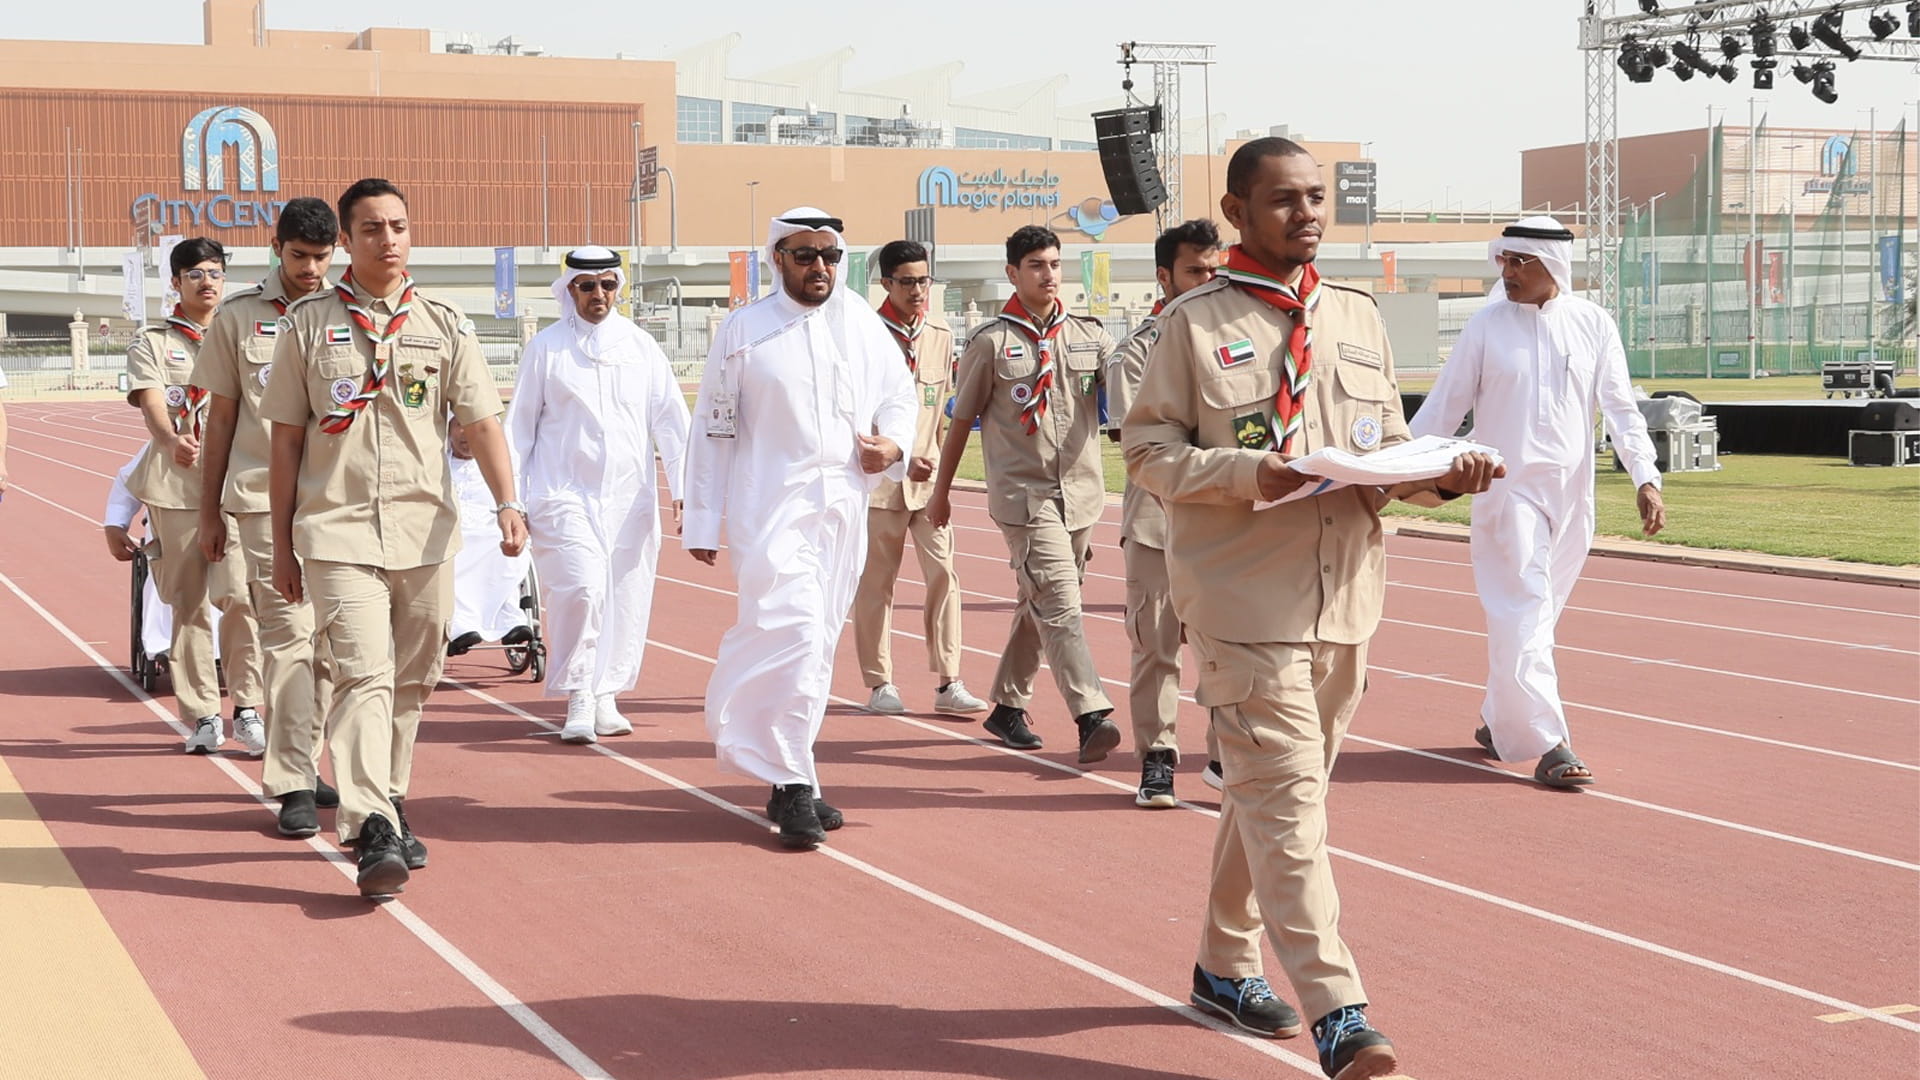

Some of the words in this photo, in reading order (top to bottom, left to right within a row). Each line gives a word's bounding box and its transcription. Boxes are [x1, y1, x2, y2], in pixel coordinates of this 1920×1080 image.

[959, 168, 1009, 188] بلانيت
[1012, 168, 1060, 188] ماجيك
[1003, 189, 1060, 209] planet
[1346, 196, 1368, 204] max
